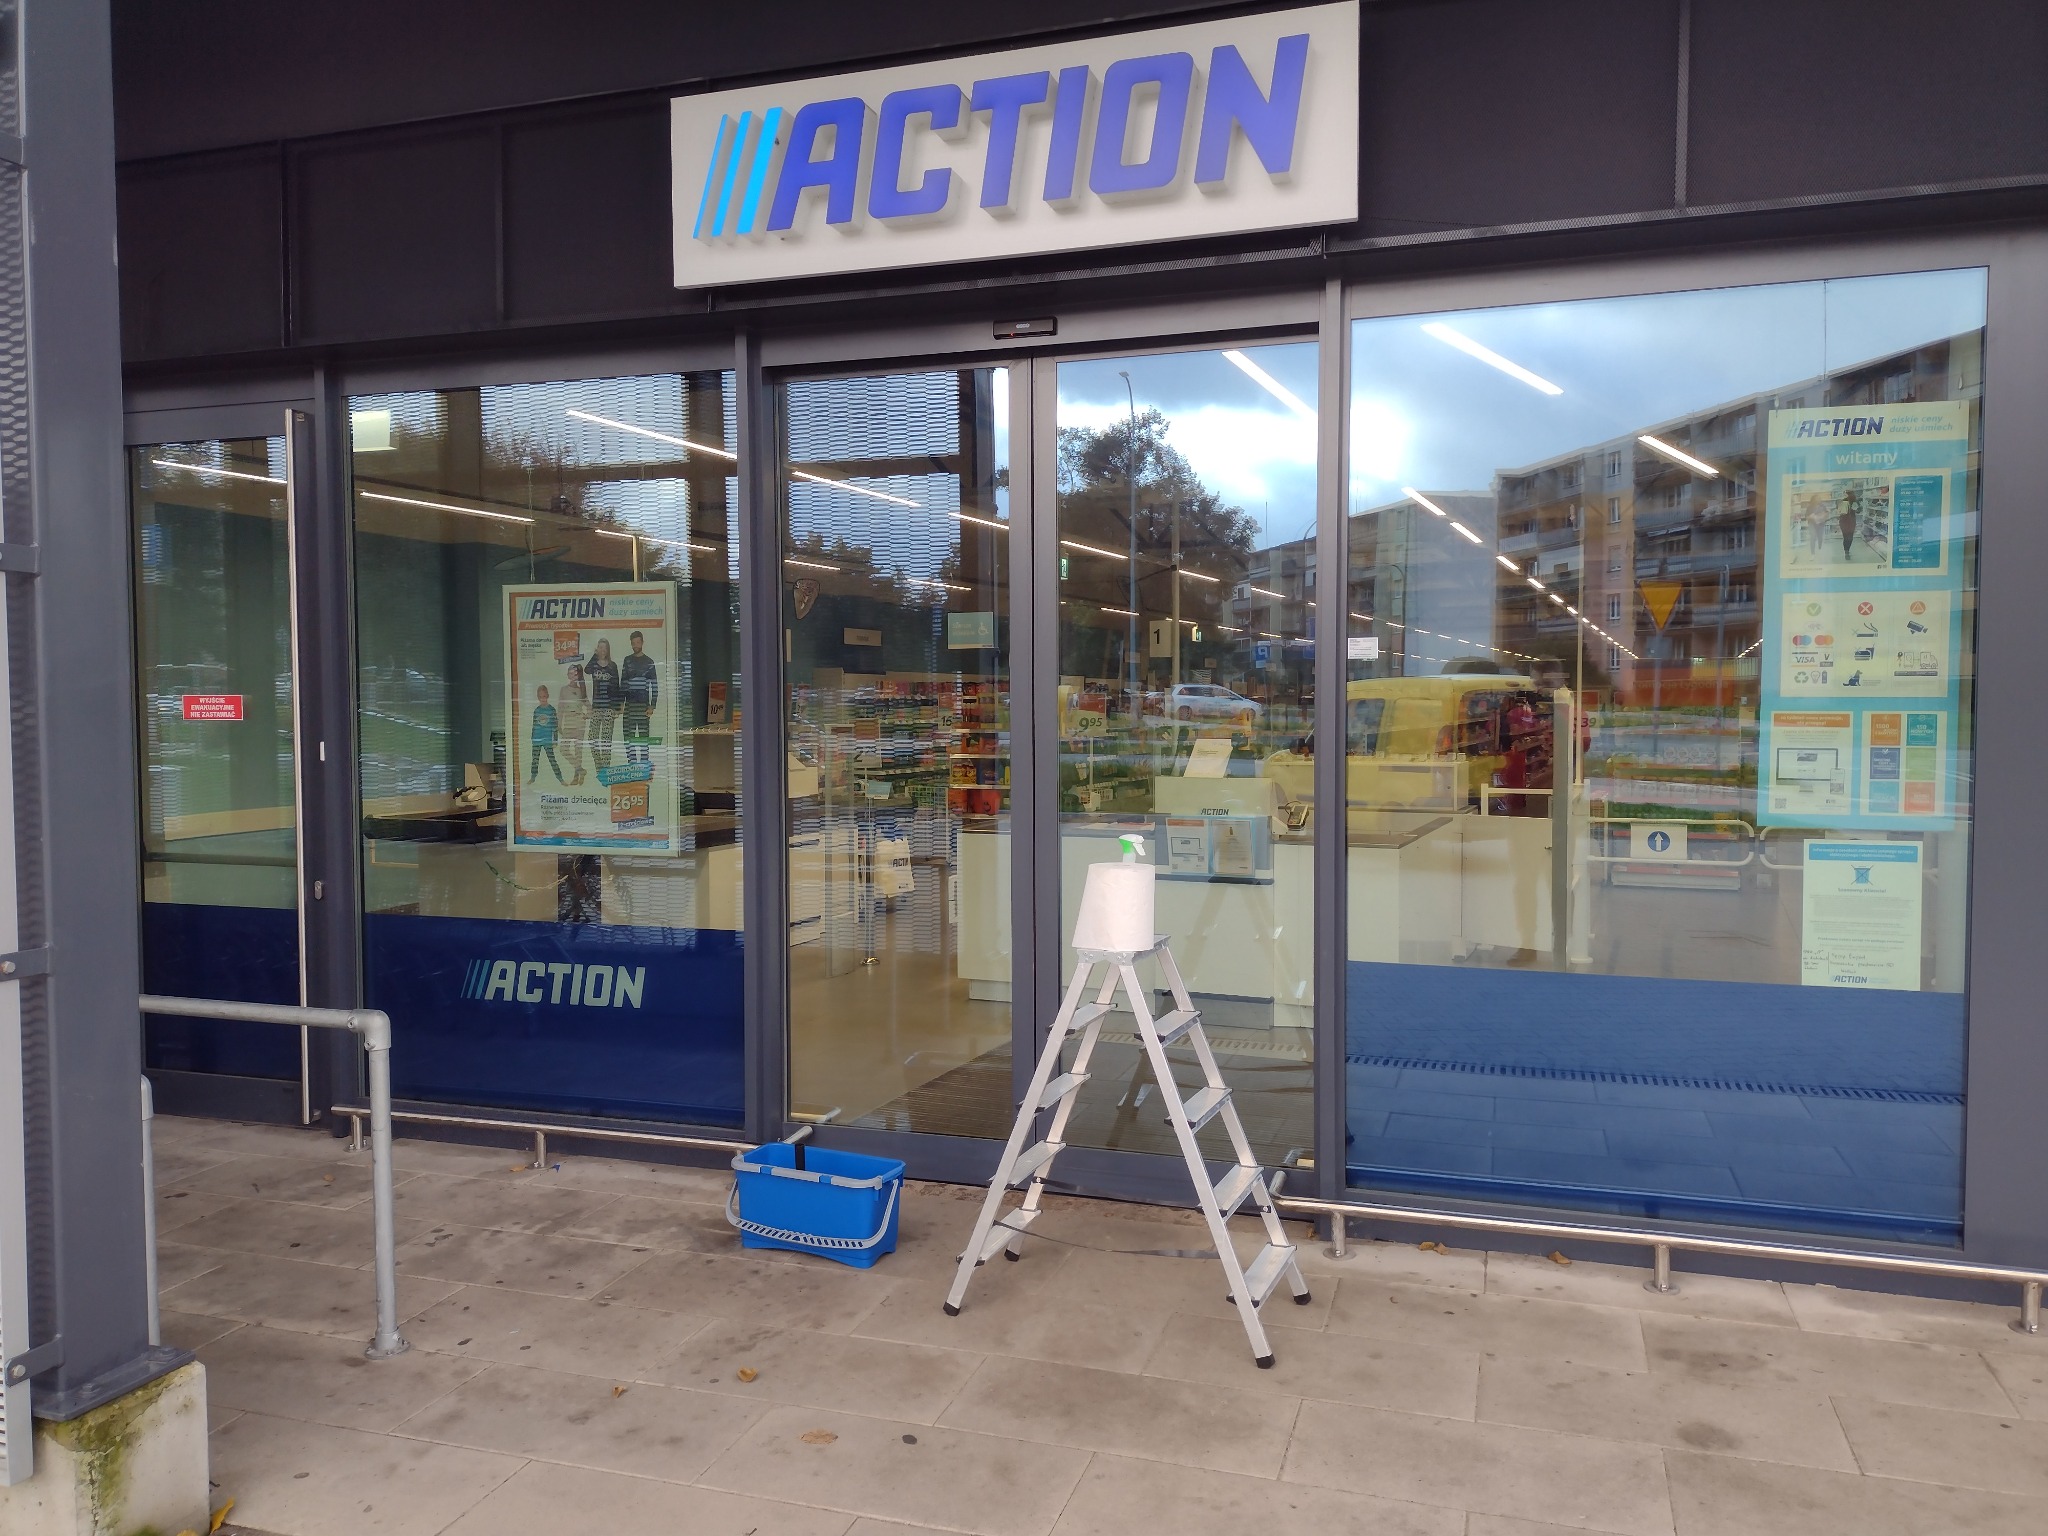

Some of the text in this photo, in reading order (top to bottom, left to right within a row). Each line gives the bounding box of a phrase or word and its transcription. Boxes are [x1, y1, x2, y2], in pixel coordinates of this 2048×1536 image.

[767, 33, 1310, 232] ACTION
[1797, 416, 1884, 438] ACTION
[1891, 415, 1943, 424] niskie ceny
[1836, 451, 1898, 466] witamy
[530, 598, 605, 619] ACTION
[635, 597, 655, 606] ceny
[1153, 628, 1161, 645] 1
[541, 795, 608, 806] Piżama dziecięca
[484, 960, 646, 1009] ACTION
[1834, 975, 1868, 984] ACTION
